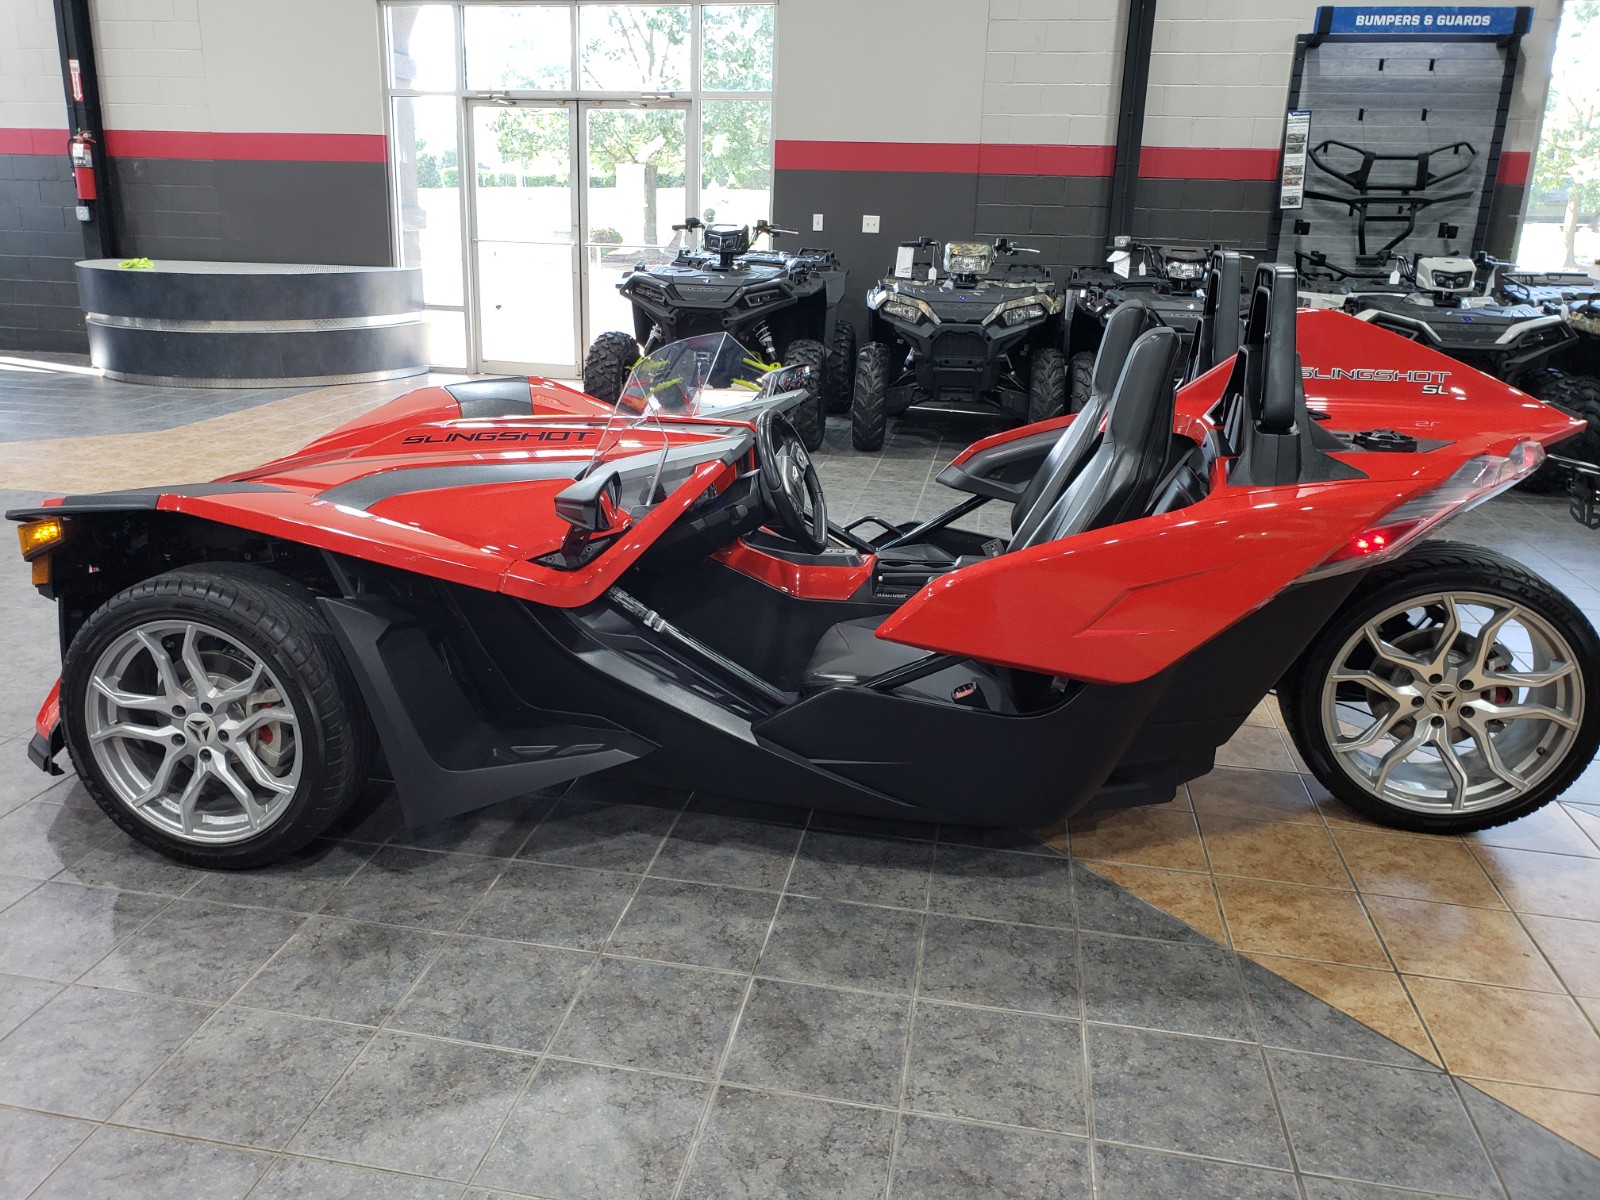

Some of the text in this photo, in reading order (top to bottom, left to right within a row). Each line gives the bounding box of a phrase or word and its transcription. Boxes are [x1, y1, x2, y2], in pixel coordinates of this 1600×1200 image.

[1355, 15, 1491, 26] BUMPERS & GUARDS
[1300, 366, 1452, 383] SLINGSHOT
[1421, 384, 1450, 394] SL
[402, 431, 596, 445] SLINGSHOT
